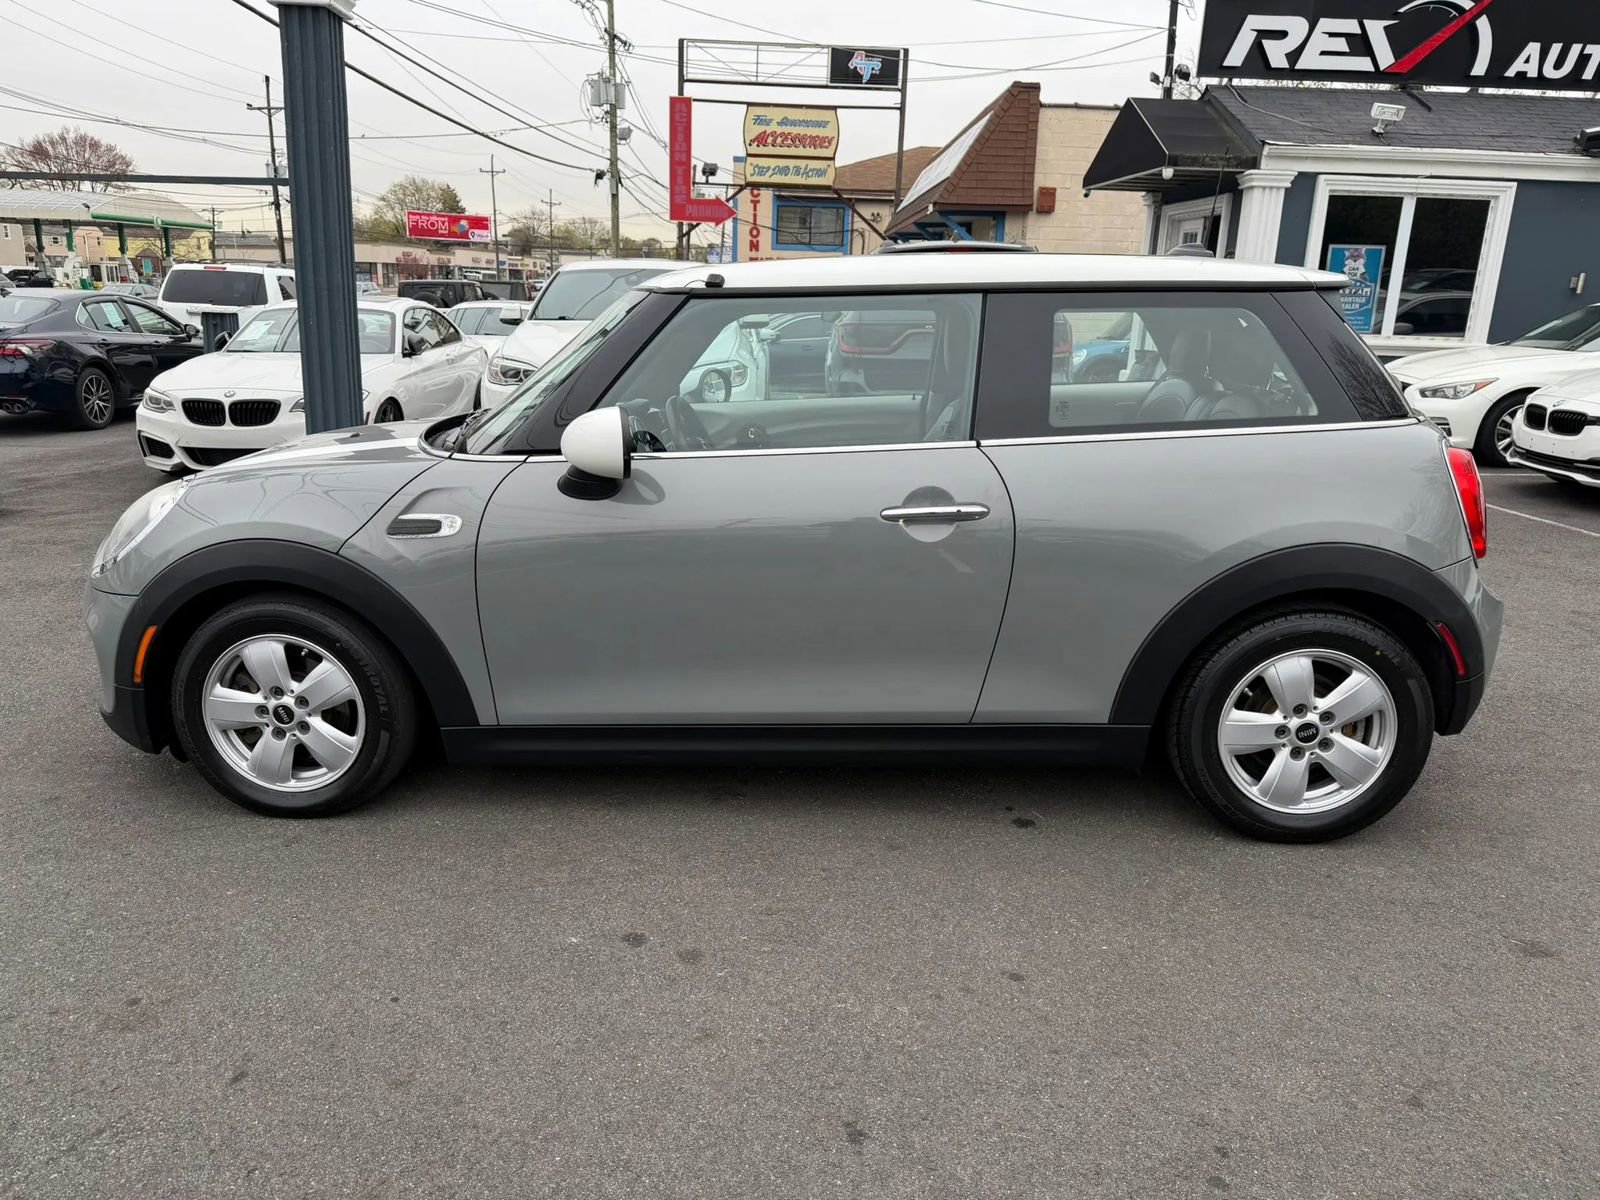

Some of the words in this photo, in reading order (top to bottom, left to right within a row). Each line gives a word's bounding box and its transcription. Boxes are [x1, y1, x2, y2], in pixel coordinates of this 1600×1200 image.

[1222, 0, 1490, 73] REV
[749, 129, 835, 150] ACCESSORIES
[409, 219, 449, 230] FROM
[276, 706, 290, 722] MINI
[1298, 727, 1317, 739] MINI
